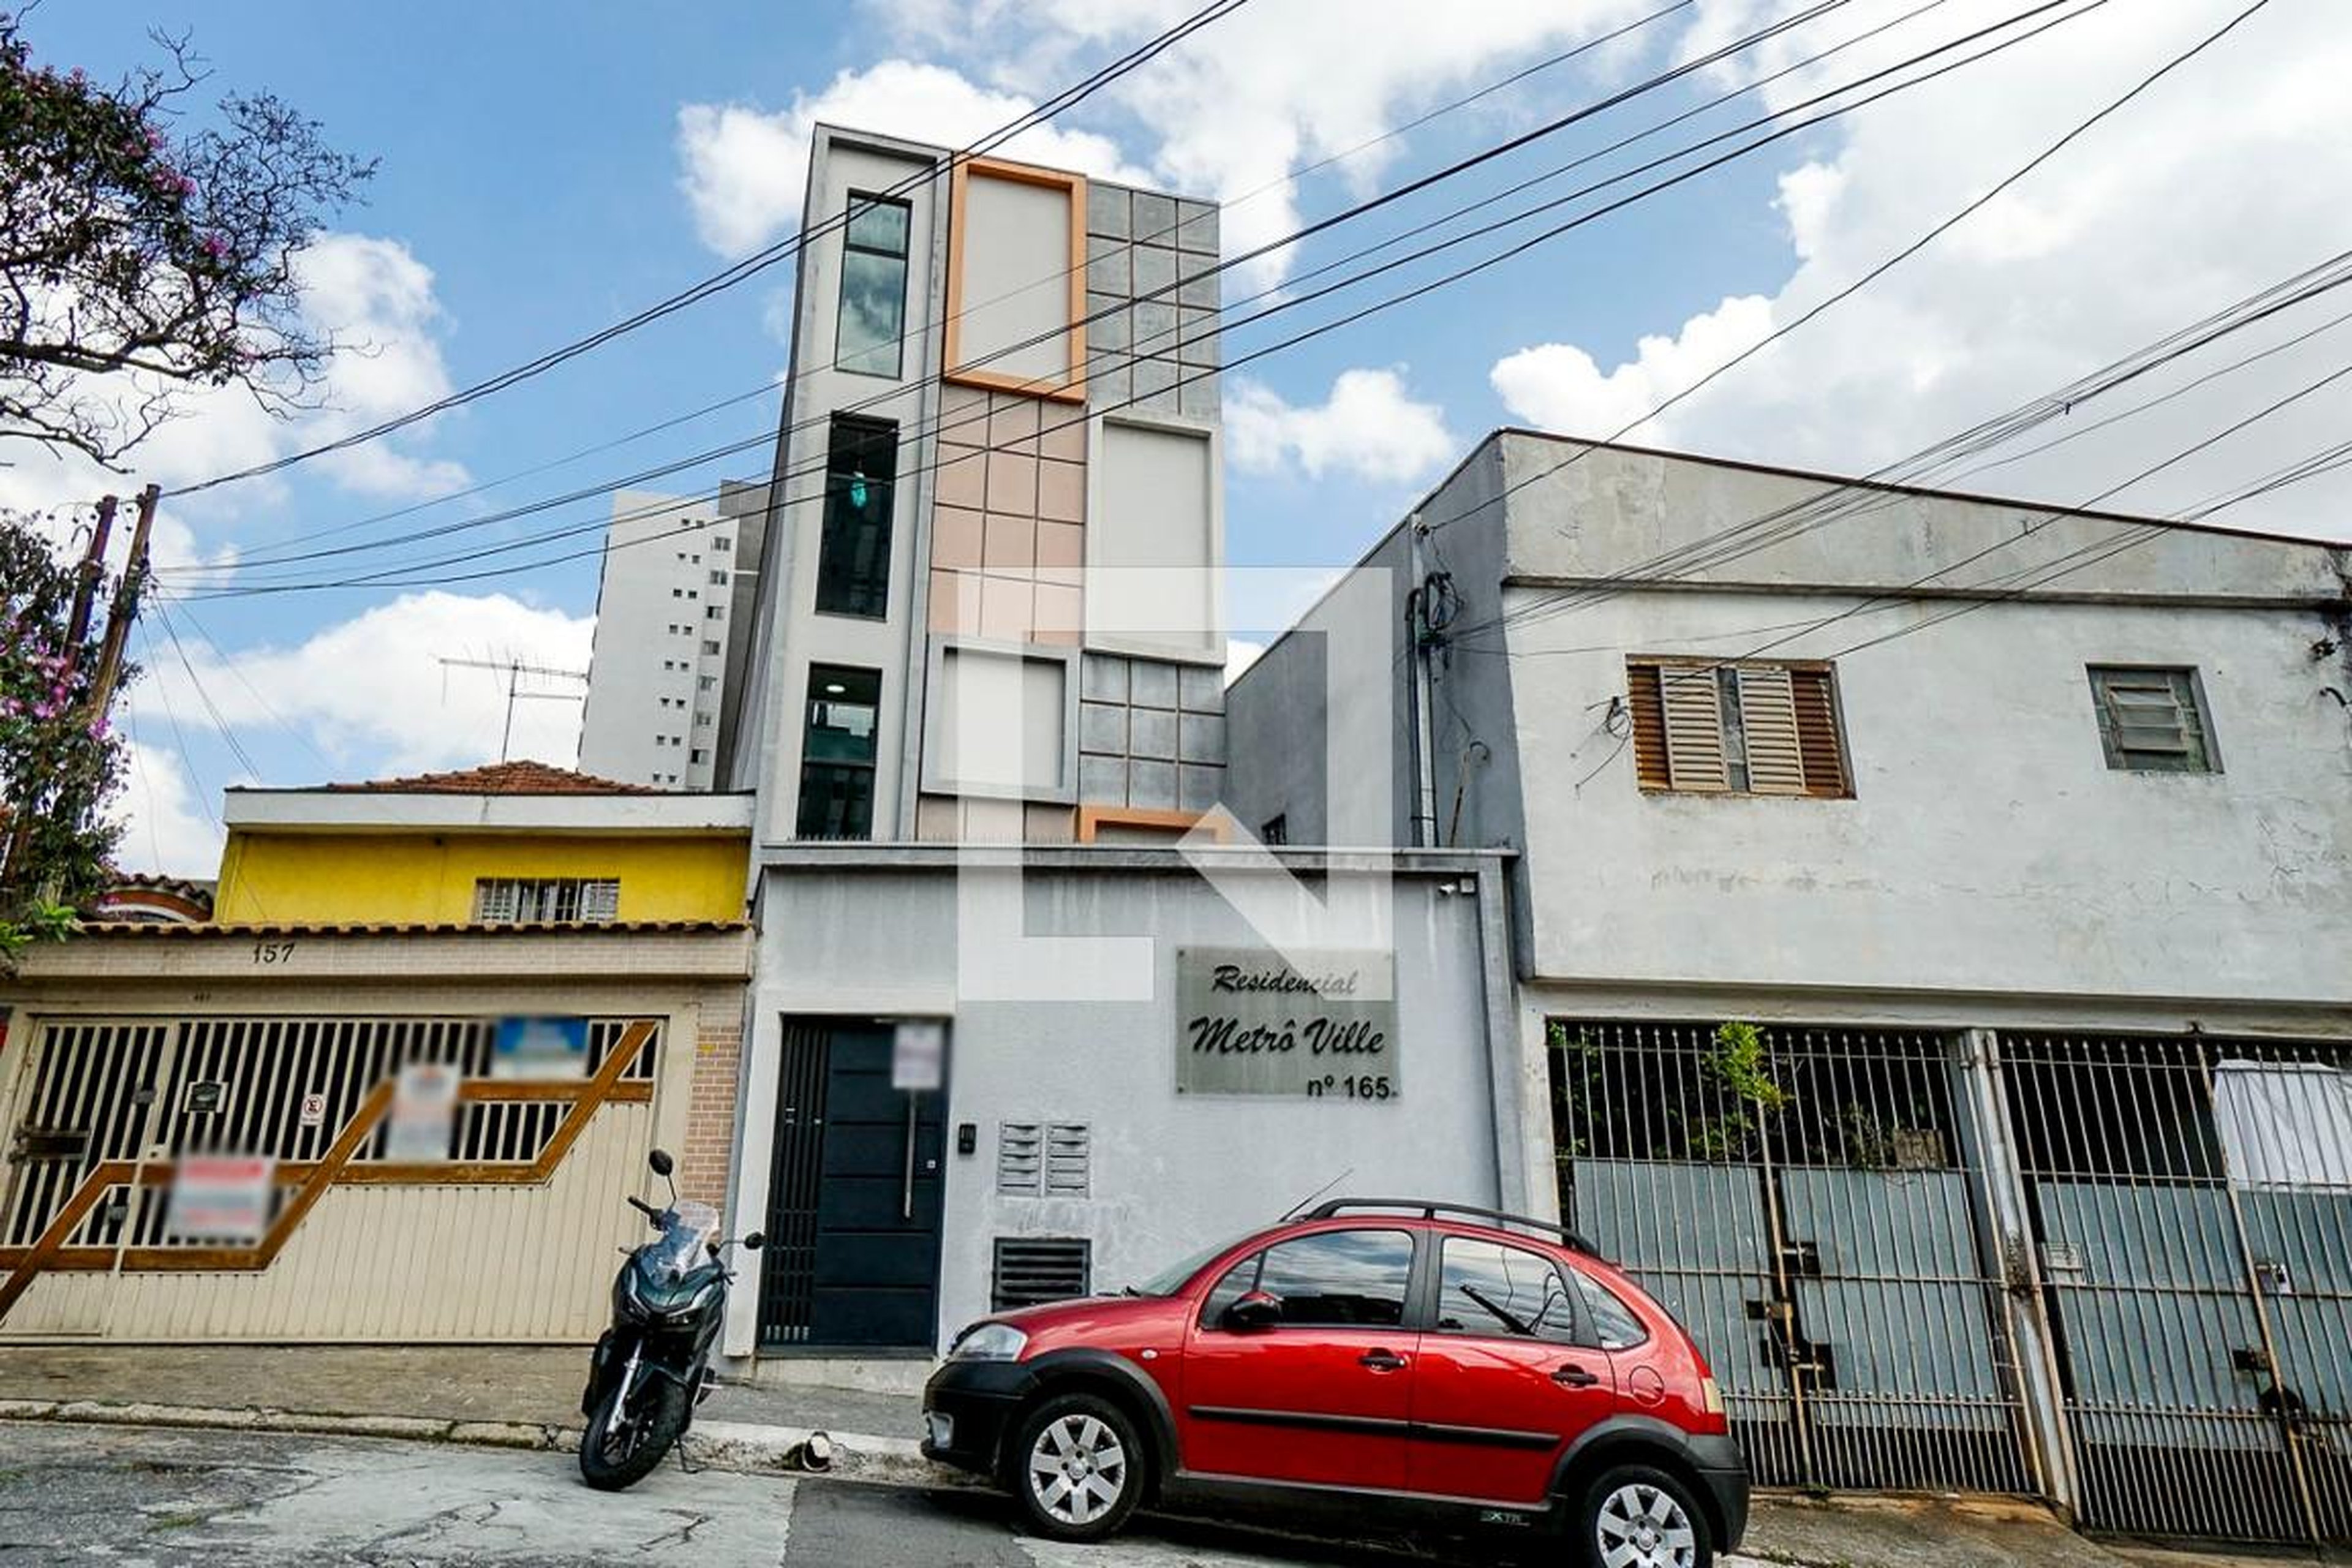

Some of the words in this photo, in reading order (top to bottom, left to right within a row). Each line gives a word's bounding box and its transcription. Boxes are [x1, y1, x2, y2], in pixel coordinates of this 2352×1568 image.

[254, 943, 295, 963] 157
[1212, 964, 1359, 994] Residencial
[1188, 1016, 1297, 1054] Metrô
[1303, 1017, 1385, 1055] Ville
[1344, 1075, 1390, 1098] 165
